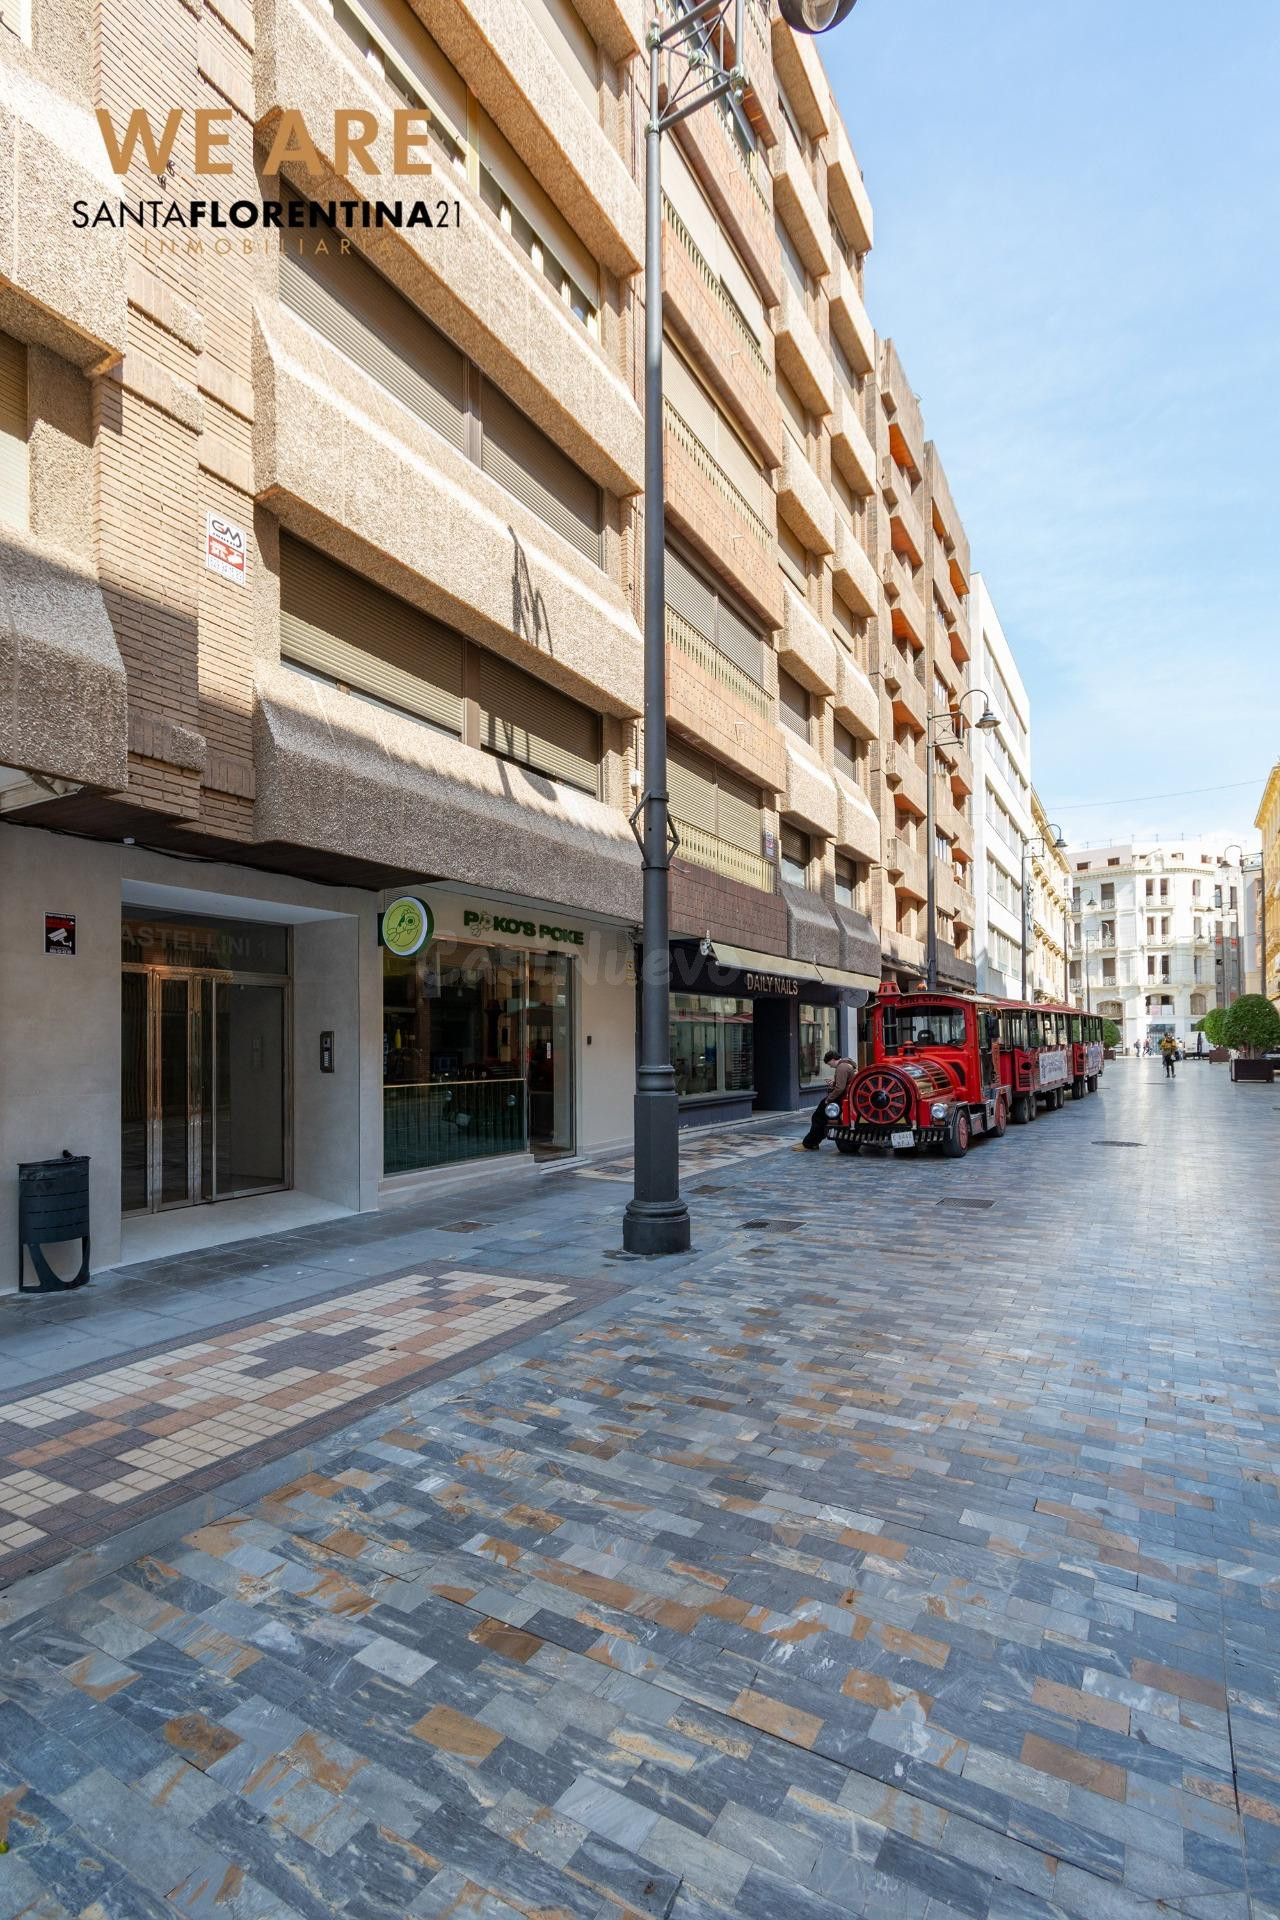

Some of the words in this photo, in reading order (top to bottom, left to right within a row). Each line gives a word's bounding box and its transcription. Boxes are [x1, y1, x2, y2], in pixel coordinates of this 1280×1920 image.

[539, 924, 585, 945] POKE
[747, 972, 773, 993] DAILY
[774, 976, 799, 996] NAILS
